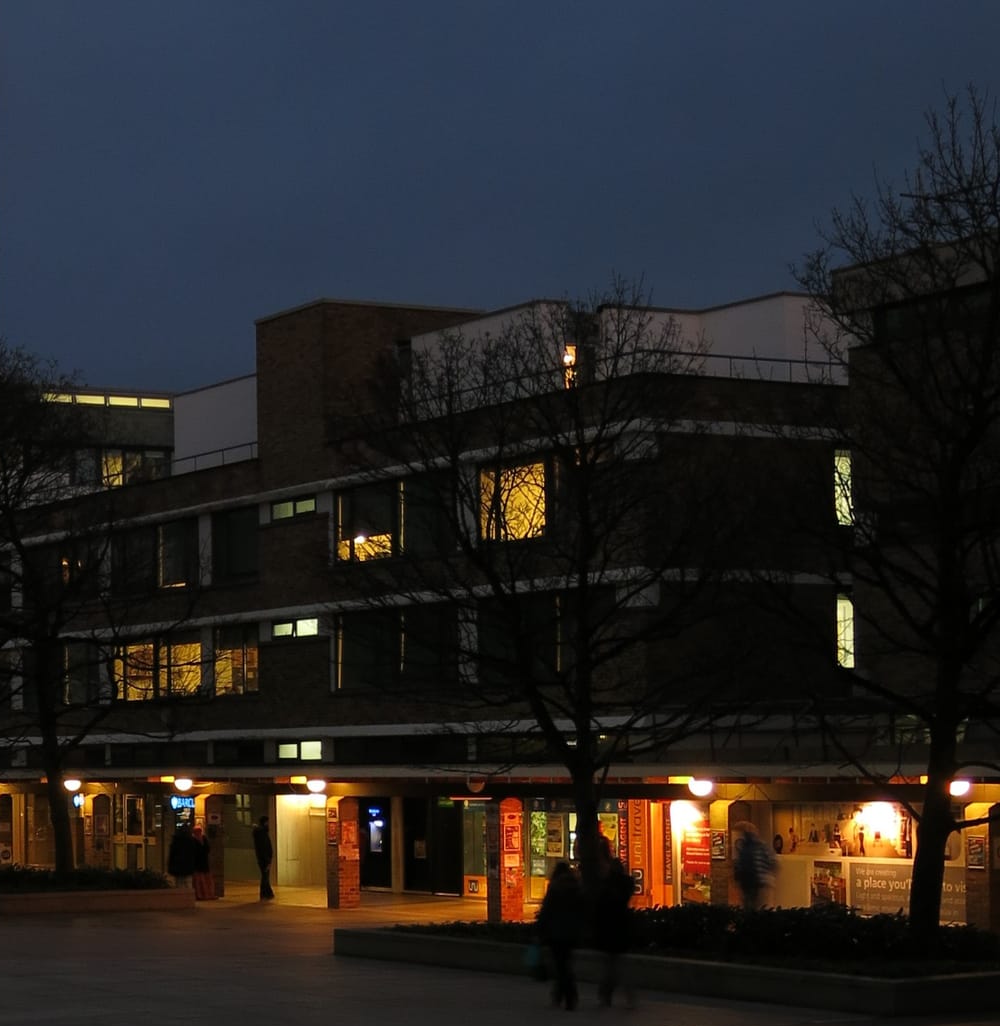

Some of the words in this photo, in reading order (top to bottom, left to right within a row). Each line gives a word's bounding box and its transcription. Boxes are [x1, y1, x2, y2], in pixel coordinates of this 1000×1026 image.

[855, 879, 862, 888] a
[863, 877, 887, 890] place
[888, 878, 912, 892] you'l
[955, 880, 967, 893] vis
